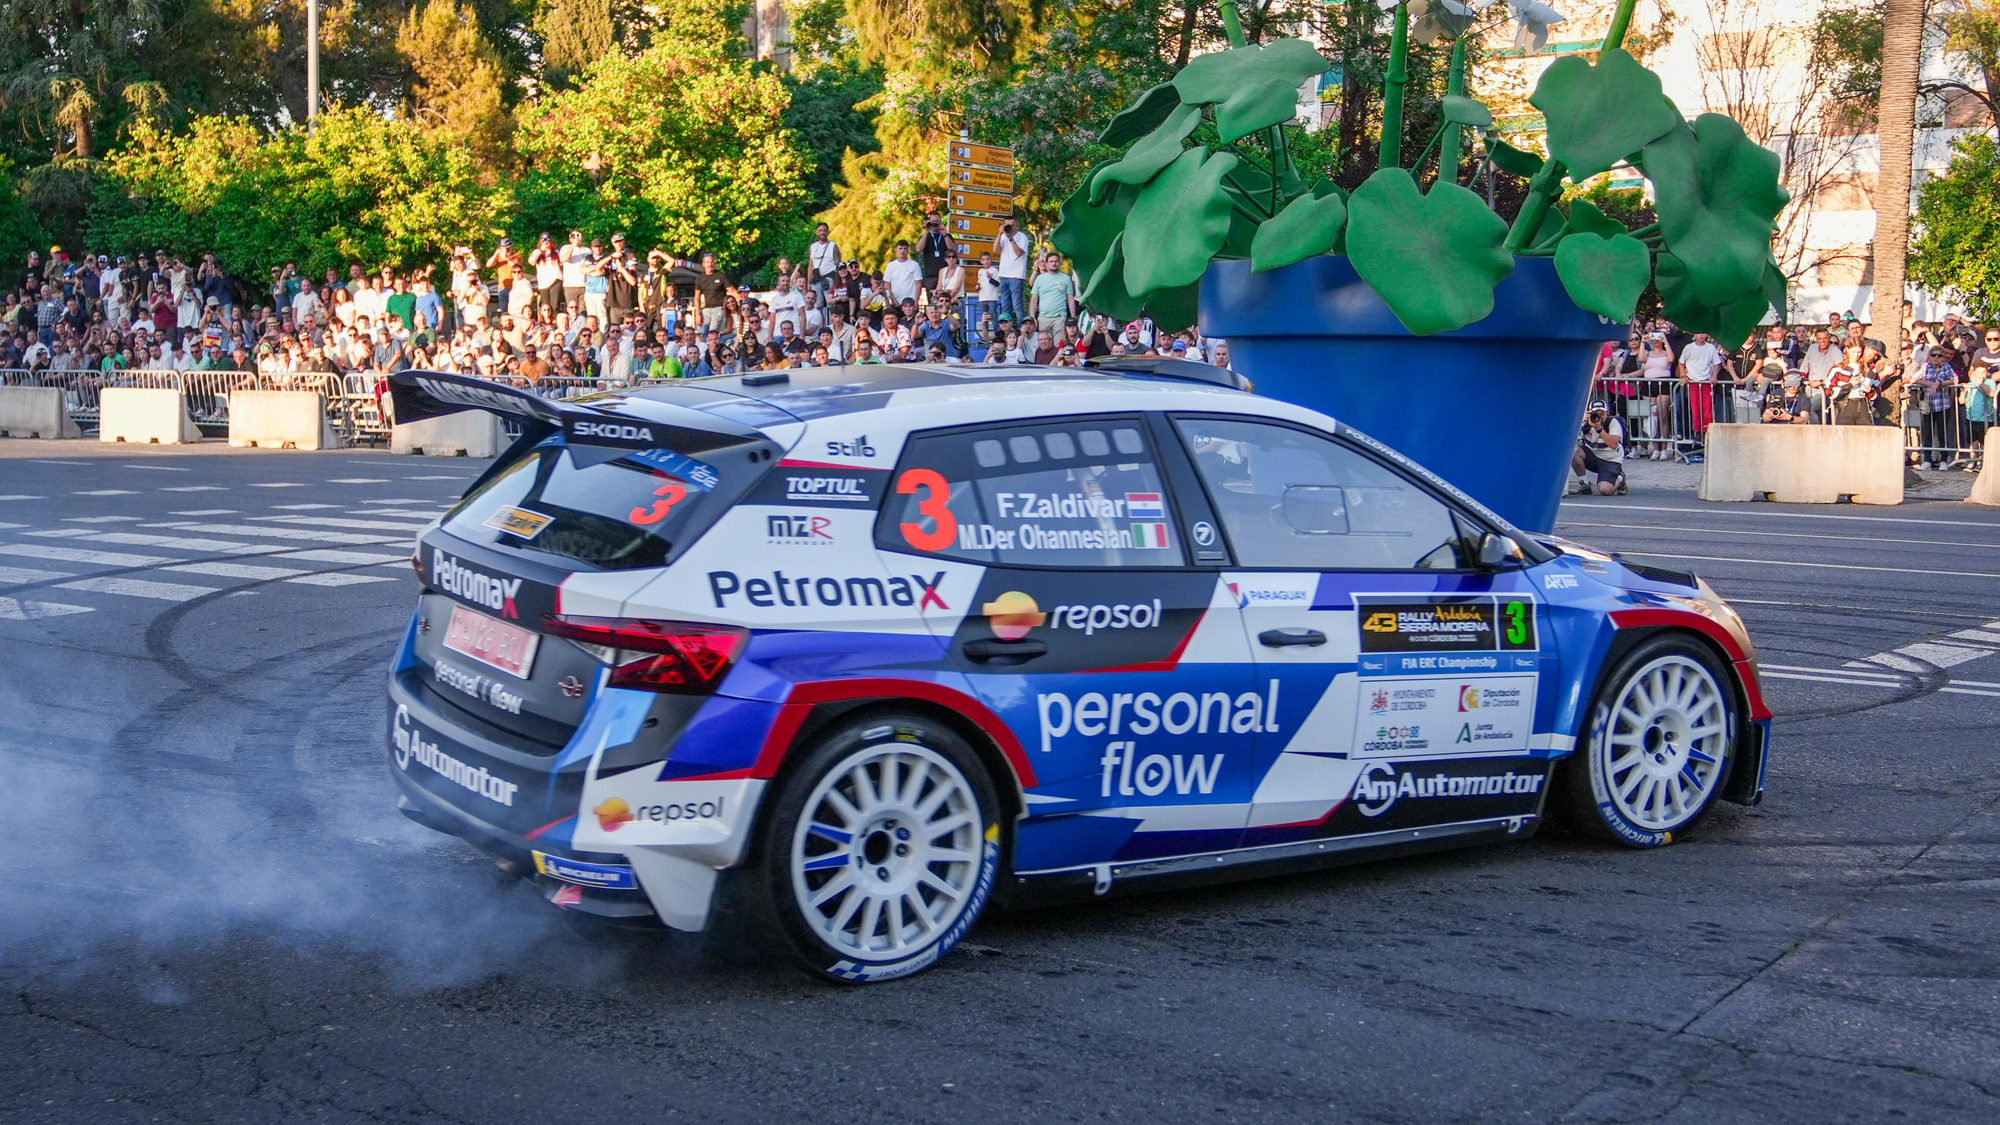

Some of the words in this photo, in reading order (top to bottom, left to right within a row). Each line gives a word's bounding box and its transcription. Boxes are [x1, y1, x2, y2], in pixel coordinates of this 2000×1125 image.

[573, 422, 654, 442] SKODA
[786, 477, 864, 494] TOPTUL
[628, 484, 687, 526] 3
[896, 468, 958, 551] 3
[957, 523, 1016, 550] M.Der
[1018, 523, 1133, 550] Ohannesian
[1249, 590, 1307, 600] PARAGUAY
[1050, 598, 1163, 636] repsol
[1362, 613, 1398, 633] 43
[1398, 611, 1436, 622] RALLY
[1440, 622, 1491, 632] MORENA
[1506, 601, 1527, 645] 3
[1401, 657, 1417, 669] FIA
[1419, 657, 1437, 669] ERC
[1438, 656, 1498, 670] Championship
[1482, 688, 1520, 699] Diputación
[1482, 700, 1491, 708] de
[1037, 678, 1280, 752] personal
[1483, 730, 1514, 740] Andalucía
[410, 730, 518, 807] Automotor
[1100, 741, 1225, 797] flow
[1397, 772, 1546, 799] Automotor
[637, 796, 725, 826] repsol
[1603, 805, 1653, 845] MICHELIN
